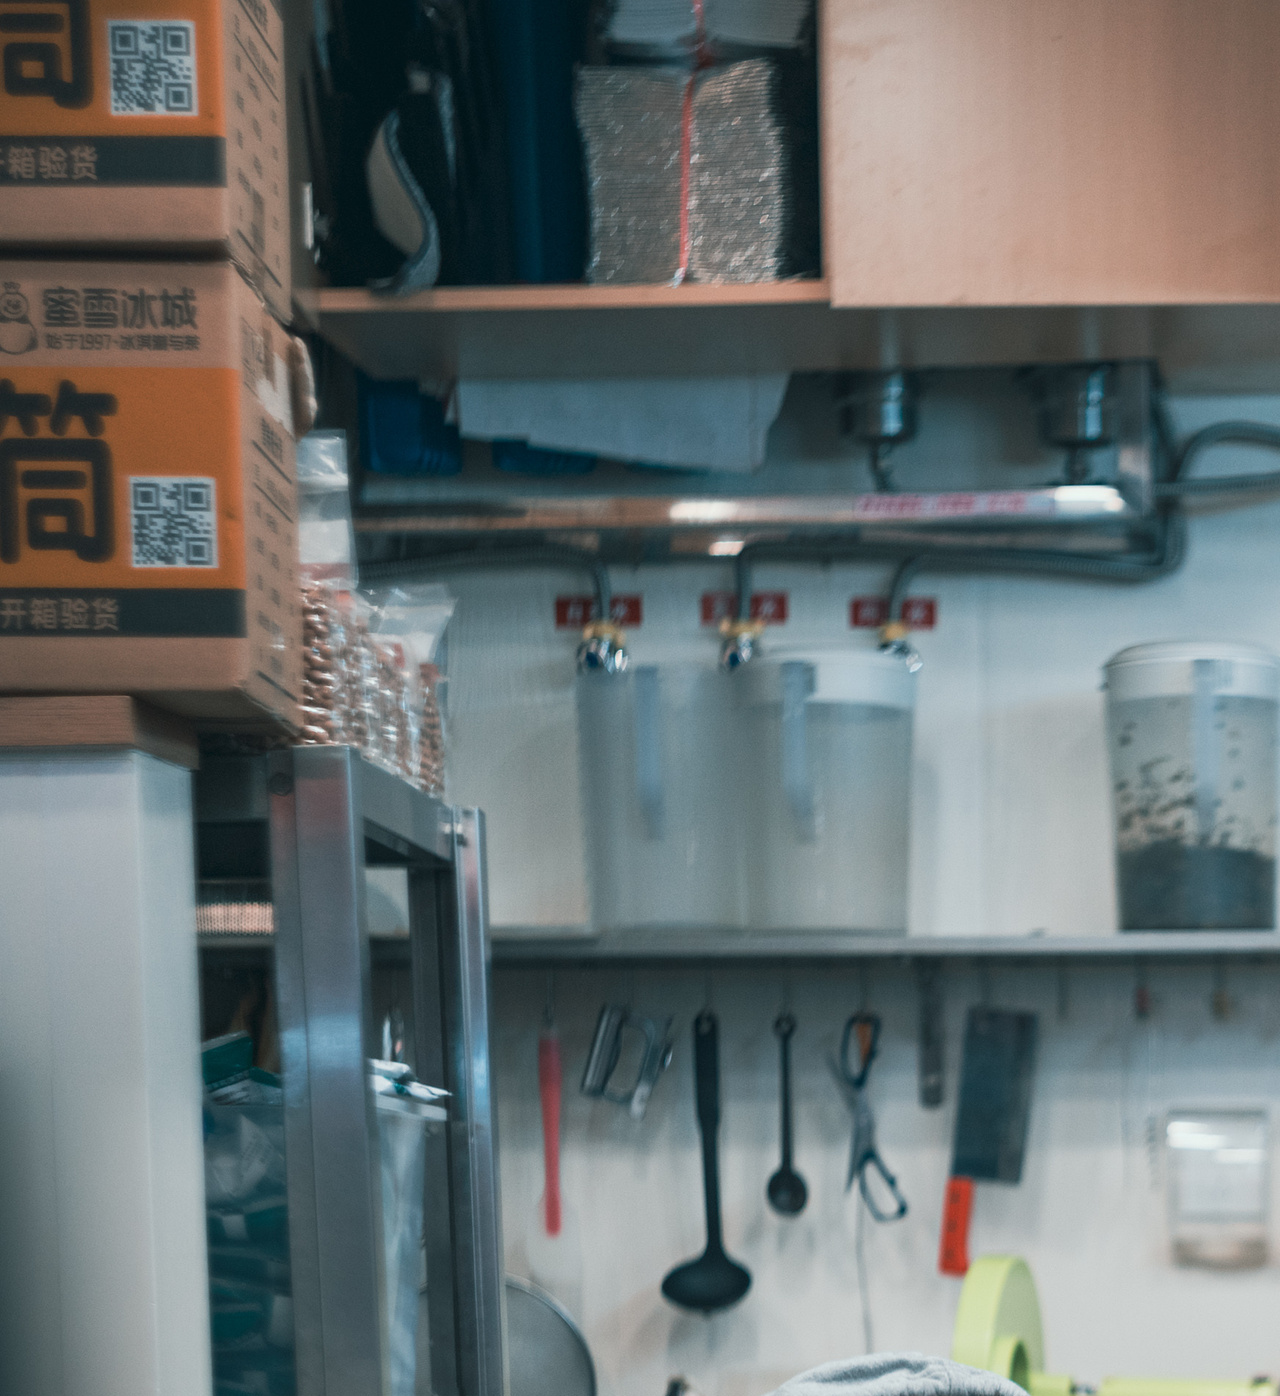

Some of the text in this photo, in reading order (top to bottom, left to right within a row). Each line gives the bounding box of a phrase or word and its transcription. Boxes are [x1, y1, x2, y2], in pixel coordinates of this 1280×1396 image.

[0, 145, 99, 180] 箱验货
[43, 285, 200, 330] 蜜雪冰城
[0, 378, 118, 565] 筒
[0, 598, 119, 631] 开箱验货
